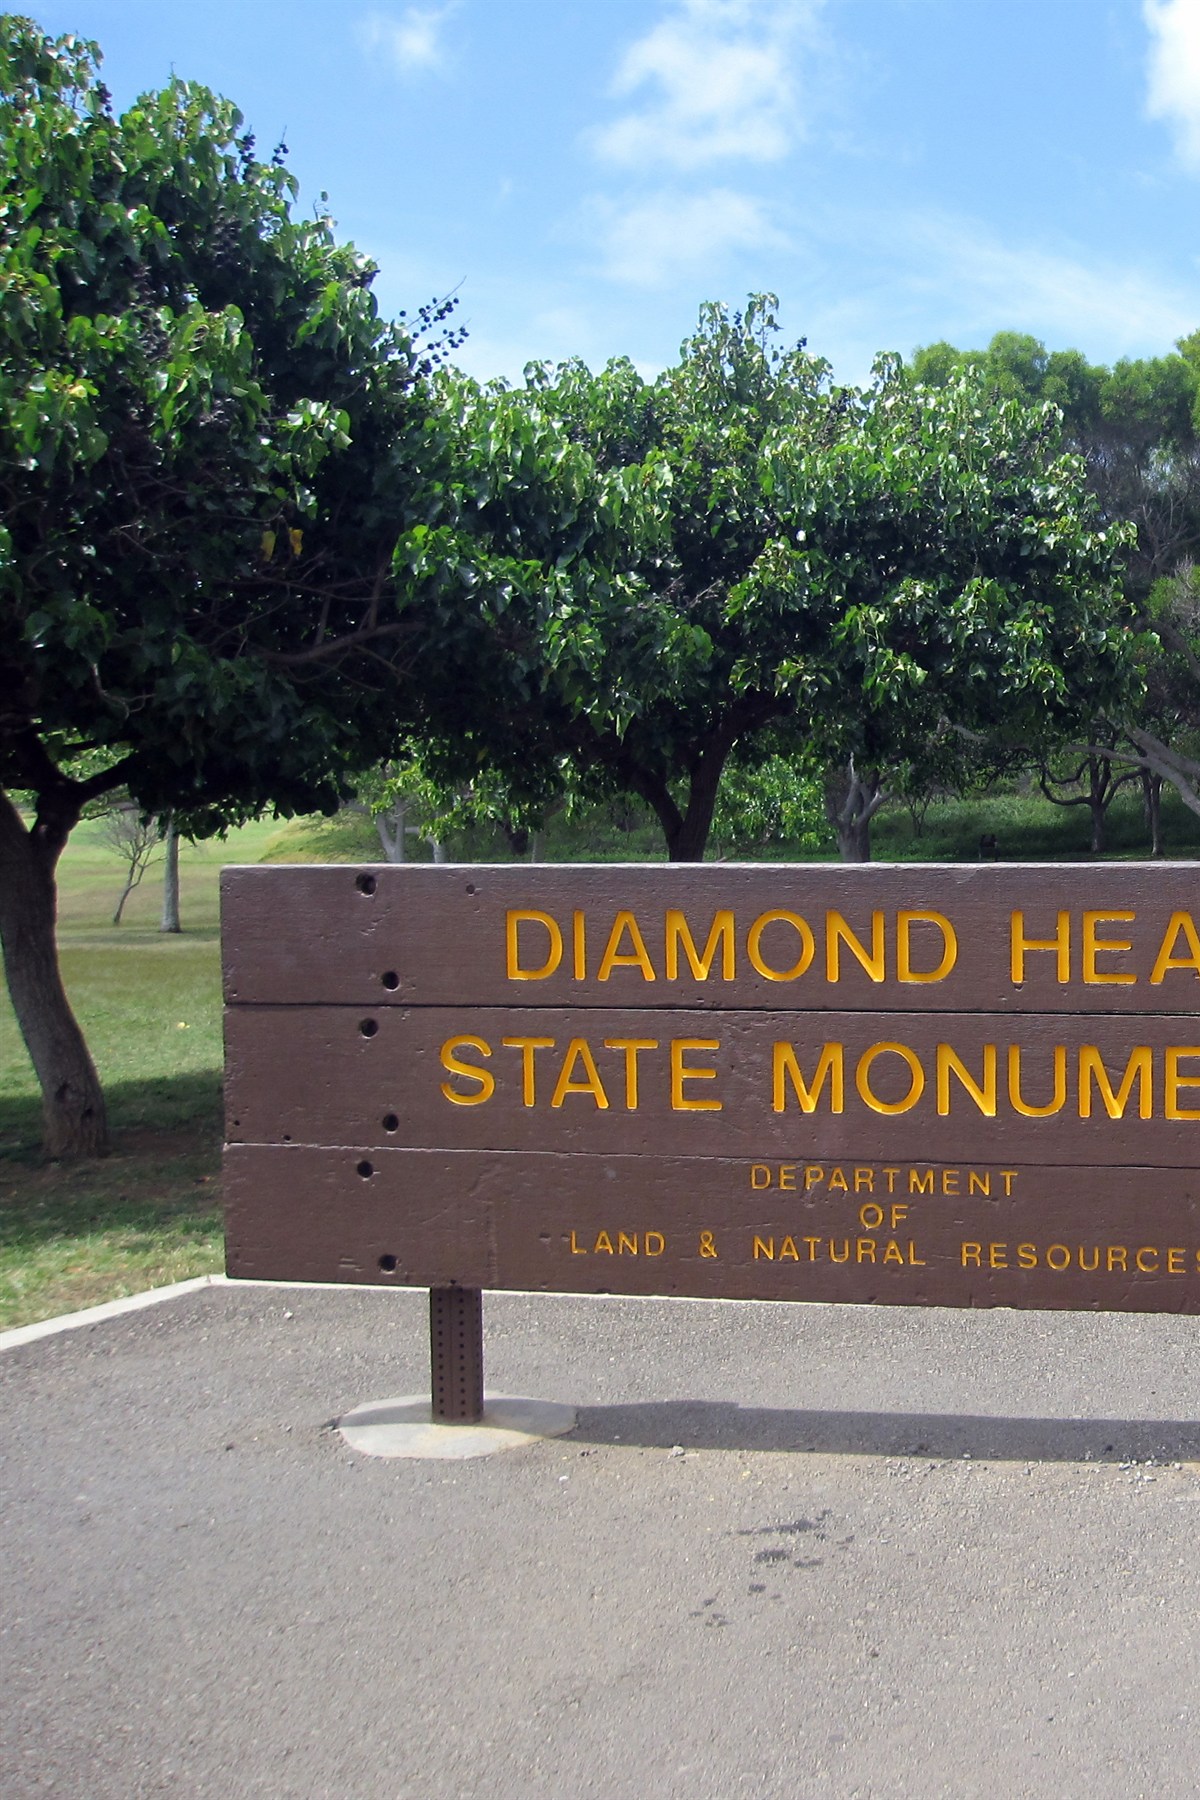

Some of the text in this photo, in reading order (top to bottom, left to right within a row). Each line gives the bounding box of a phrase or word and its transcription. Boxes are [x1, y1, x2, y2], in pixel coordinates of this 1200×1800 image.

[505, 909, 960, 983] DIAMOND
[440, 1034, 724, 1111] STATE
[749, 1163, 1020, 1197] DEPARTMENT
[857, 1202, 910, 1230] OF
[569, 1229, 667, 1257] LAND
[698, 1229, 720, 1259] &
[752, 1234, 927, 1266] NATURAL
